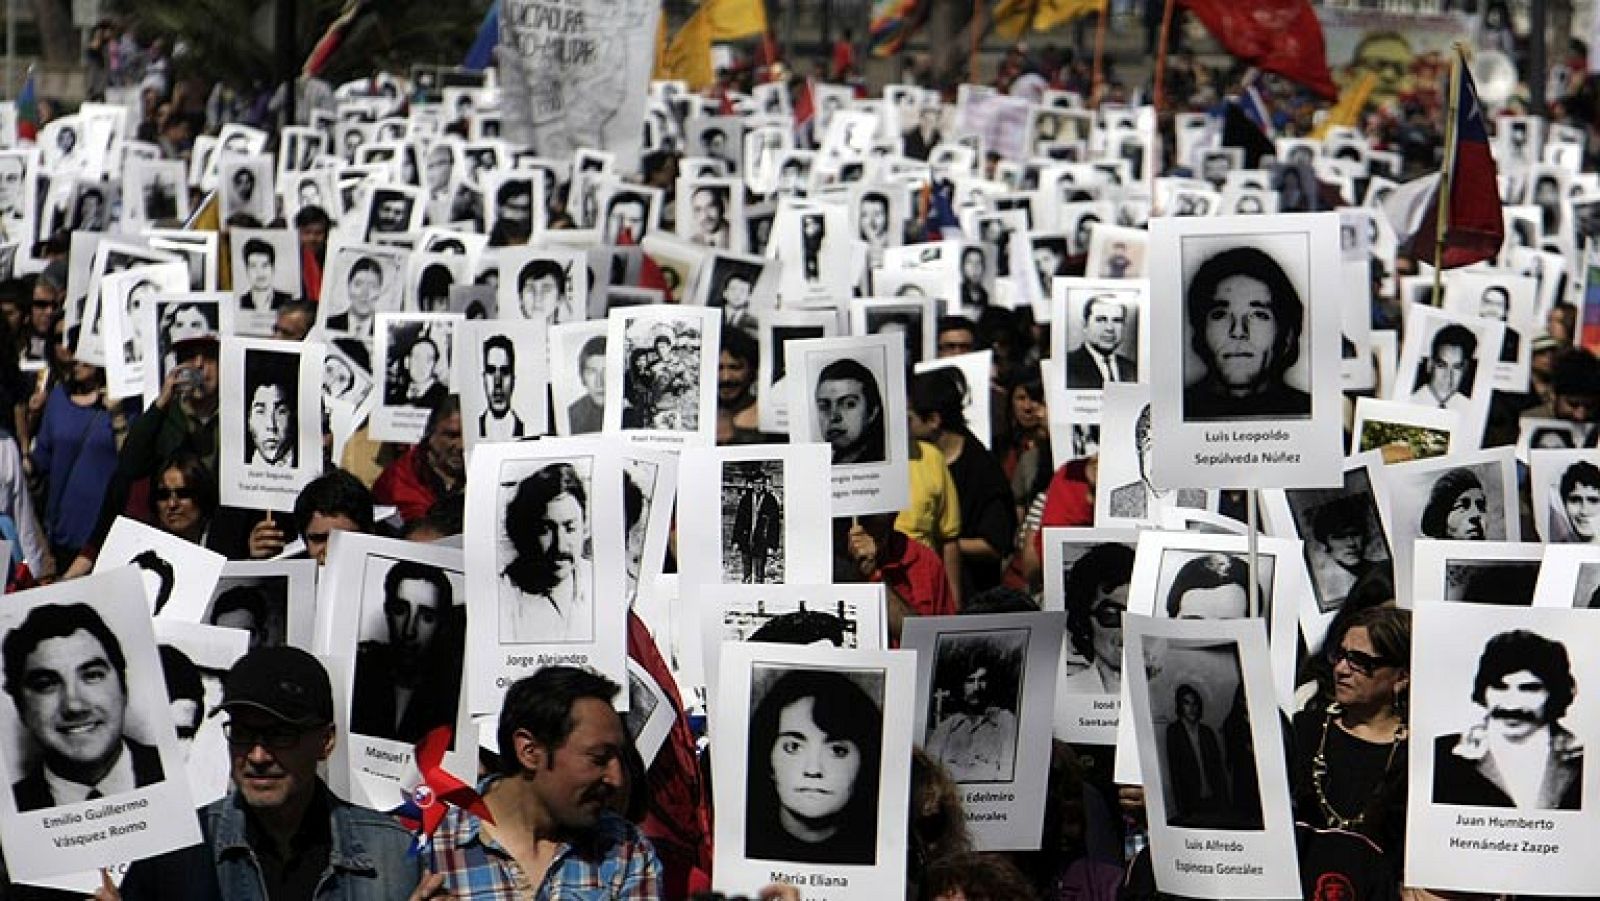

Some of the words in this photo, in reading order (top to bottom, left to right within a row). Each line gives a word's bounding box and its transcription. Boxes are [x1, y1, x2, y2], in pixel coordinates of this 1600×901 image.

[1204, 429, 1230, 442] Luis
[1232, 428, 1291, 443] Leopoldo
[1194, 452, 1259, 465] Sepúlveda
[1261, 451, 1301, 463] Núñez
[831, 477, 850, 485] ergio
[505, 655, 534, 668] Jorge
[536, 654, 589, 668] Alejandro
[1093, 700, 1116, 710] José
[1079, 717, 1120, 727] Santand
[365, 746, 403, 764] Manuel
[966, 792, 1015, 803] Edelmiro
[42, 813, 83, 829] Emilio
[85, 798, 149, 820] Guillermo
[1456, 814, 1486, 827] Juan
[1488, 816, 1556, 830] Humberto
[52, 831, 107, 848] Vásquez
[108, 821, 148, 837] Romo
[1184, 838, 1204, 852] Luis
[1205, 839, 1245, 852] Alfredo
[1449, 837, 1519, 852] Hernández
[1521, 839, 1560, 855] Zazpe
[1216, 863, 1264, 875] González
[770, 871, 807, 885] María
[809, 873, 849, 887] Eliana
